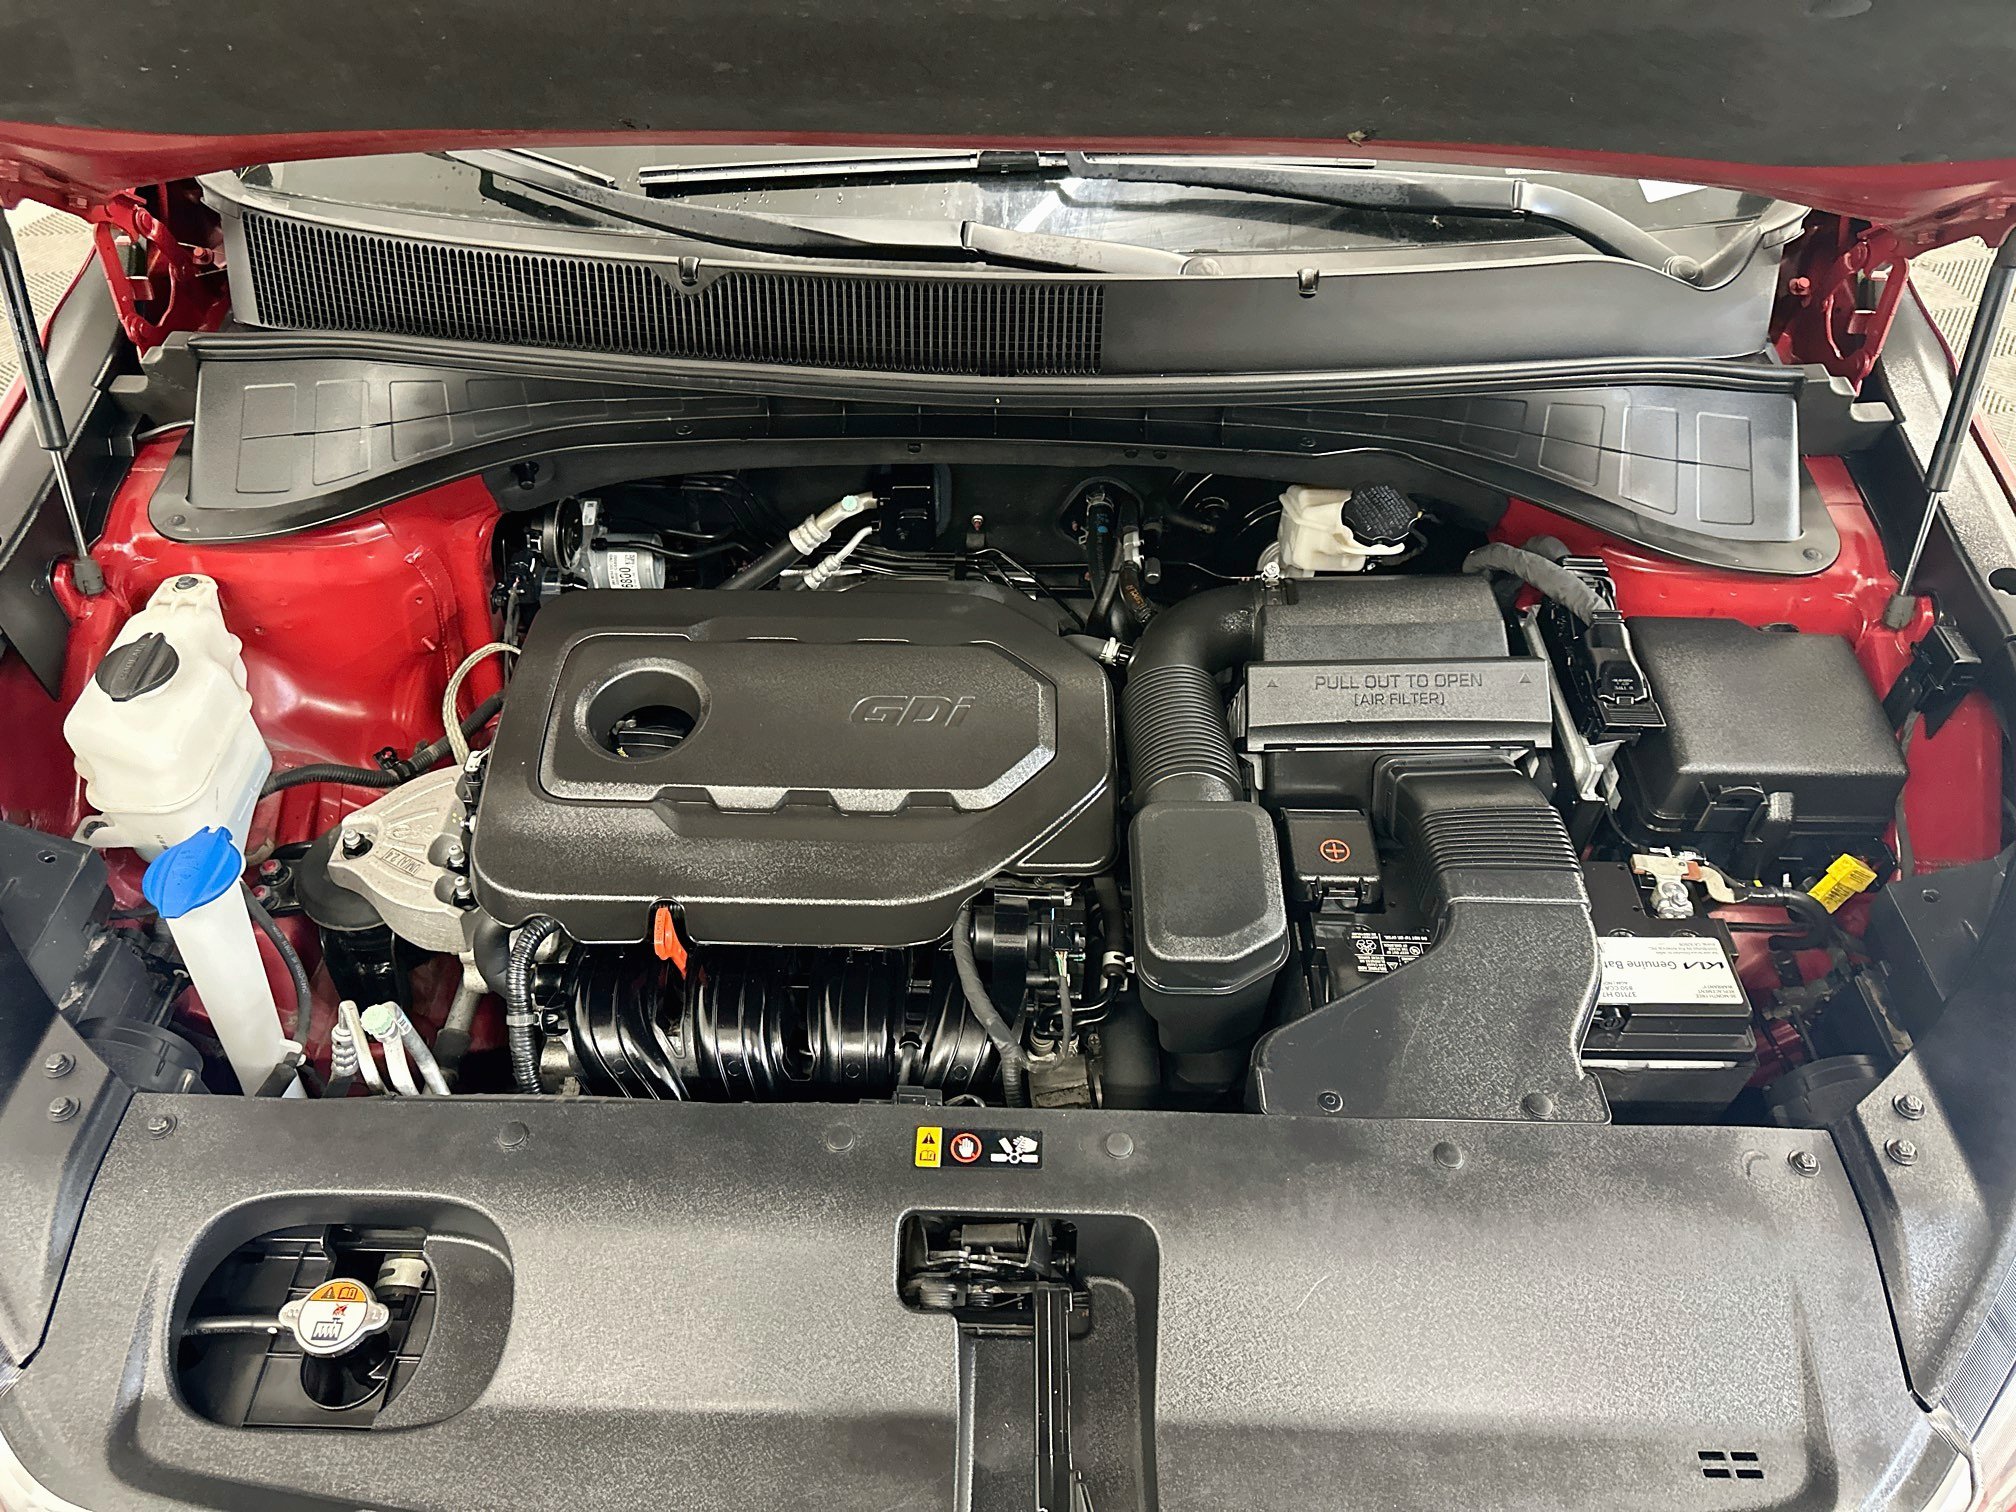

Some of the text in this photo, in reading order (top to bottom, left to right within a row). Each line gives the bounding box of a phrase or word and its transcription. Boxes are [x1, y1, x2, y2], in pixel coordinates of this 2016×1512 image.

[1315, 673, 1483, 690] PULL OUT TO OPEN
[849, 695, 976, 728] GDi
[1626, 960, 1677, 970] Genuine
[1683, 961, 1724, 970] KIA
